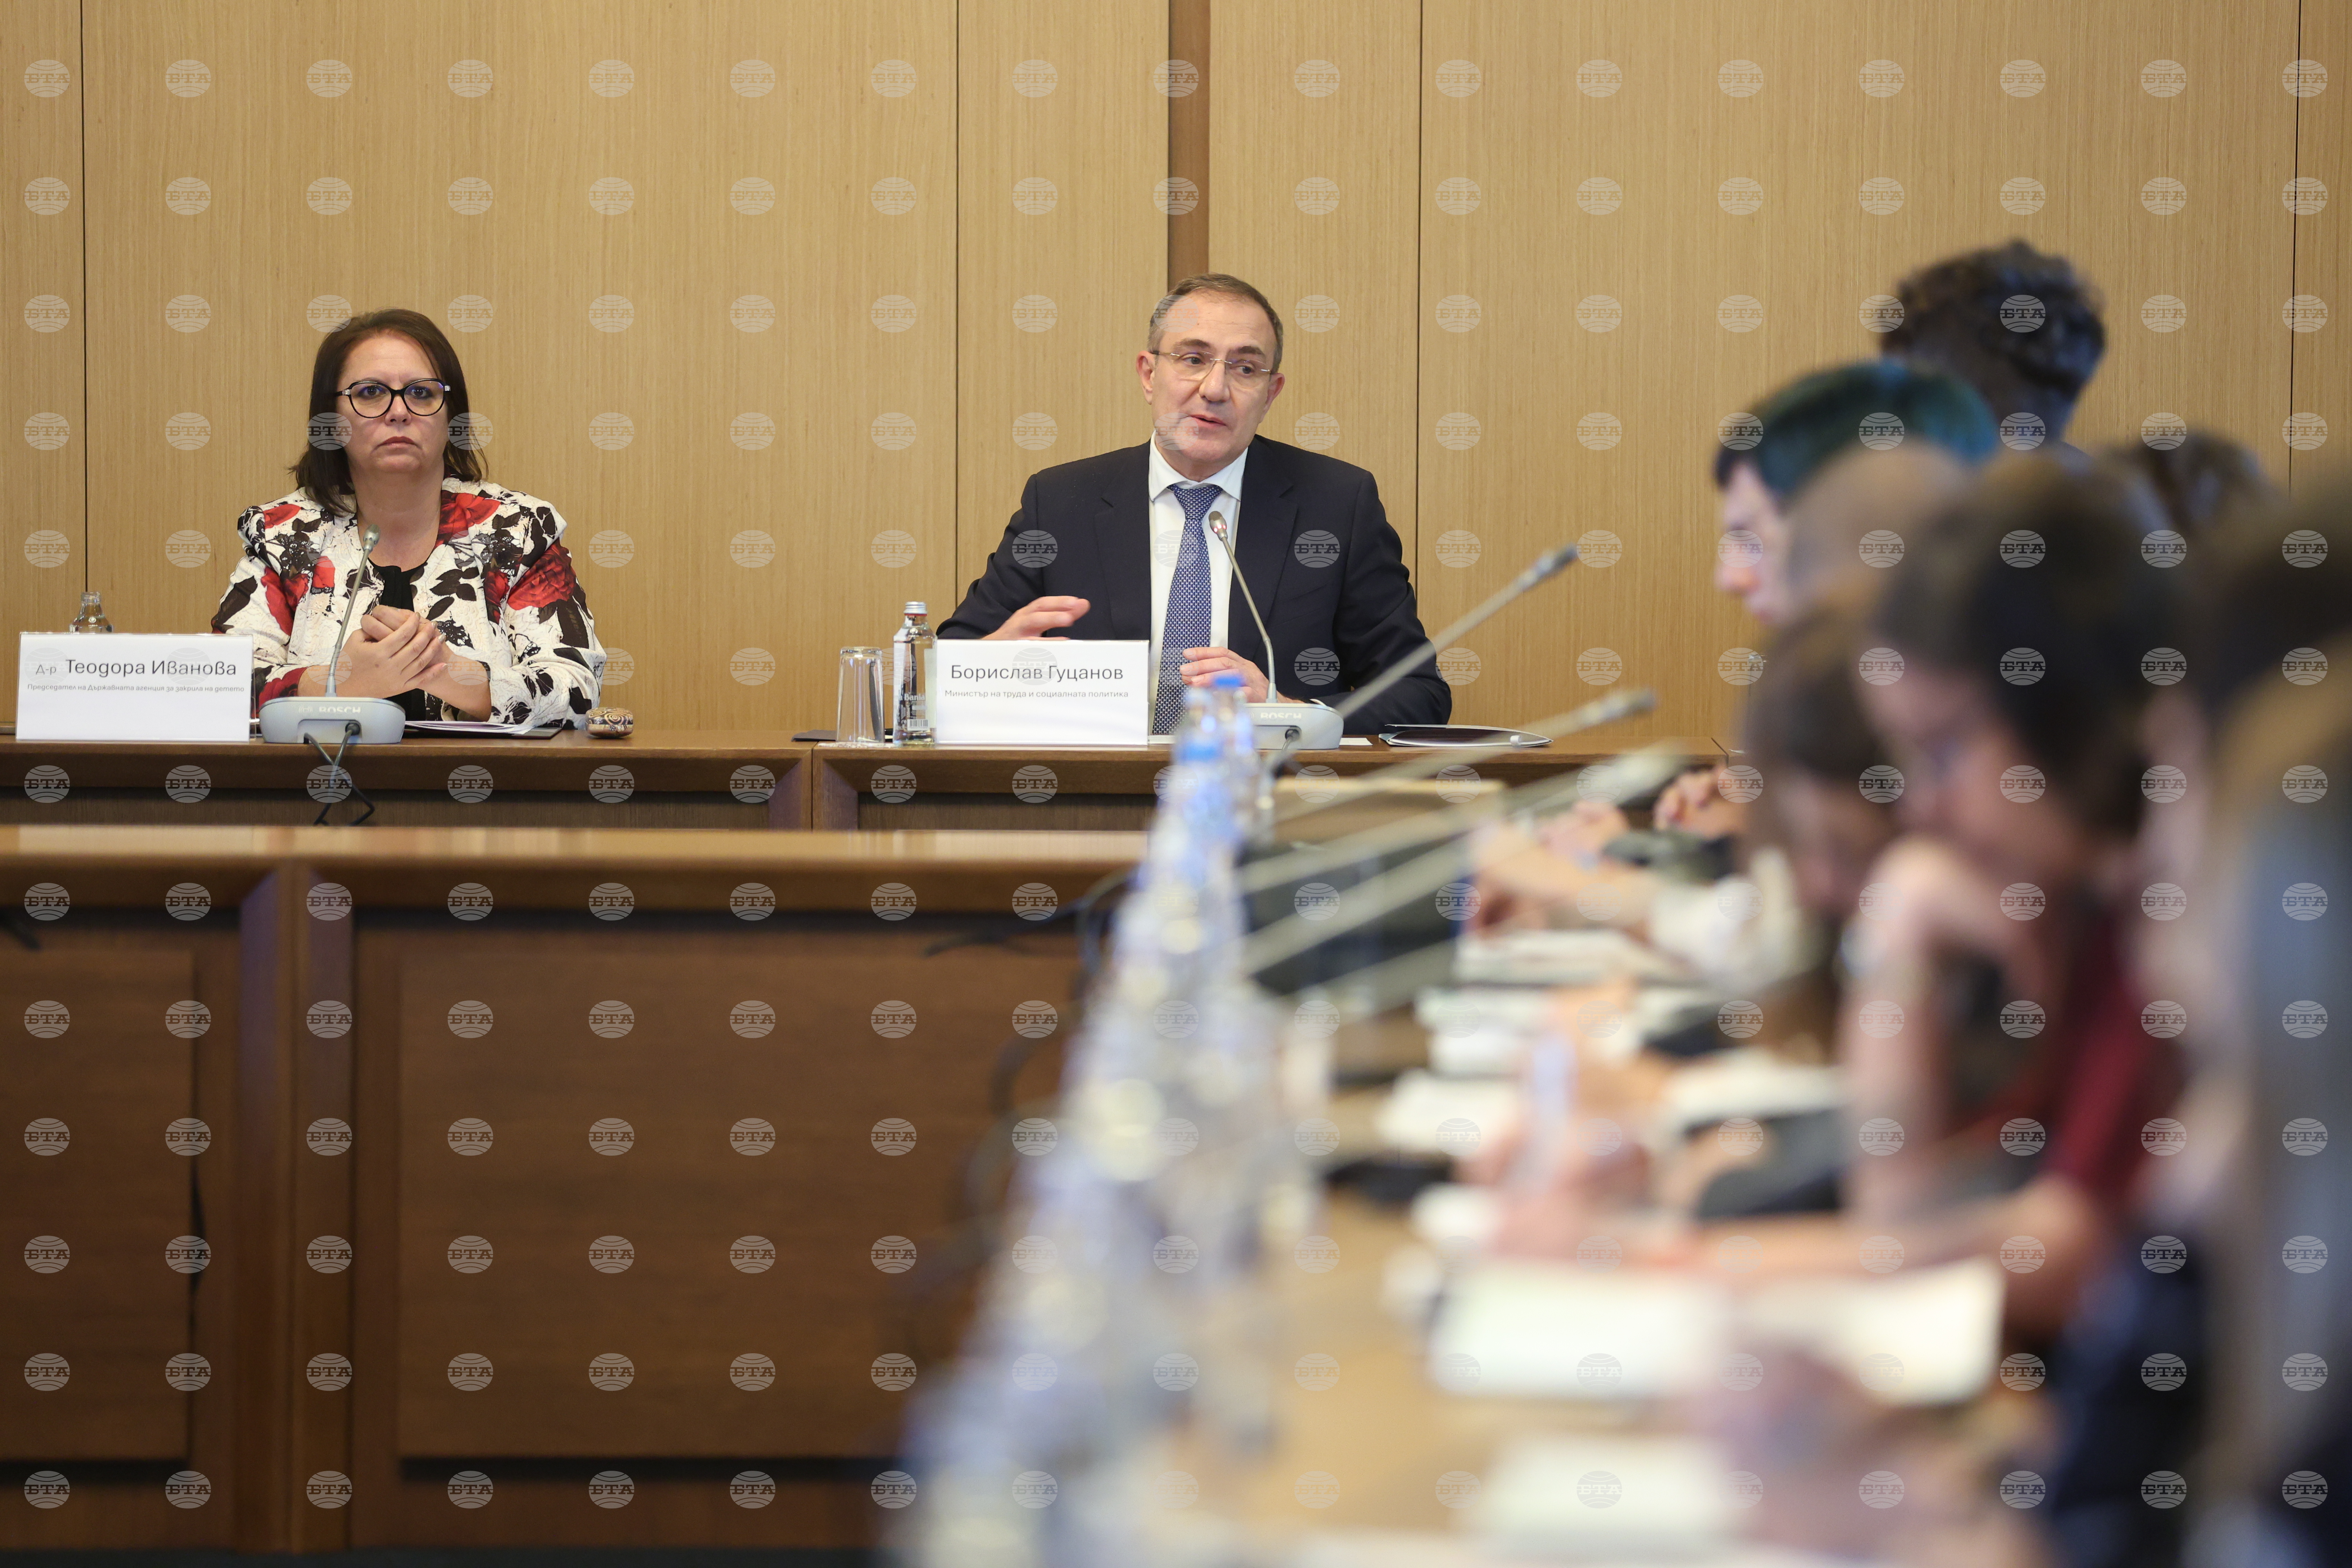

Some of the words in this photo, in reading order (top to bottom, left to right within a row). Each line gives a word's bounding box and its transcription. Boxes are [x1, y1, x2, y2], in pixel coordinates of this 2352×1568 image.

[35, 664, 56, 675] Д-р
[65, 659, 145, 677] Теодора
[152, 660, 236, 675] Иванова
[951, 665, 1042, 682] Борислав
[1049, 666, 1123, 682] Гуцанов
